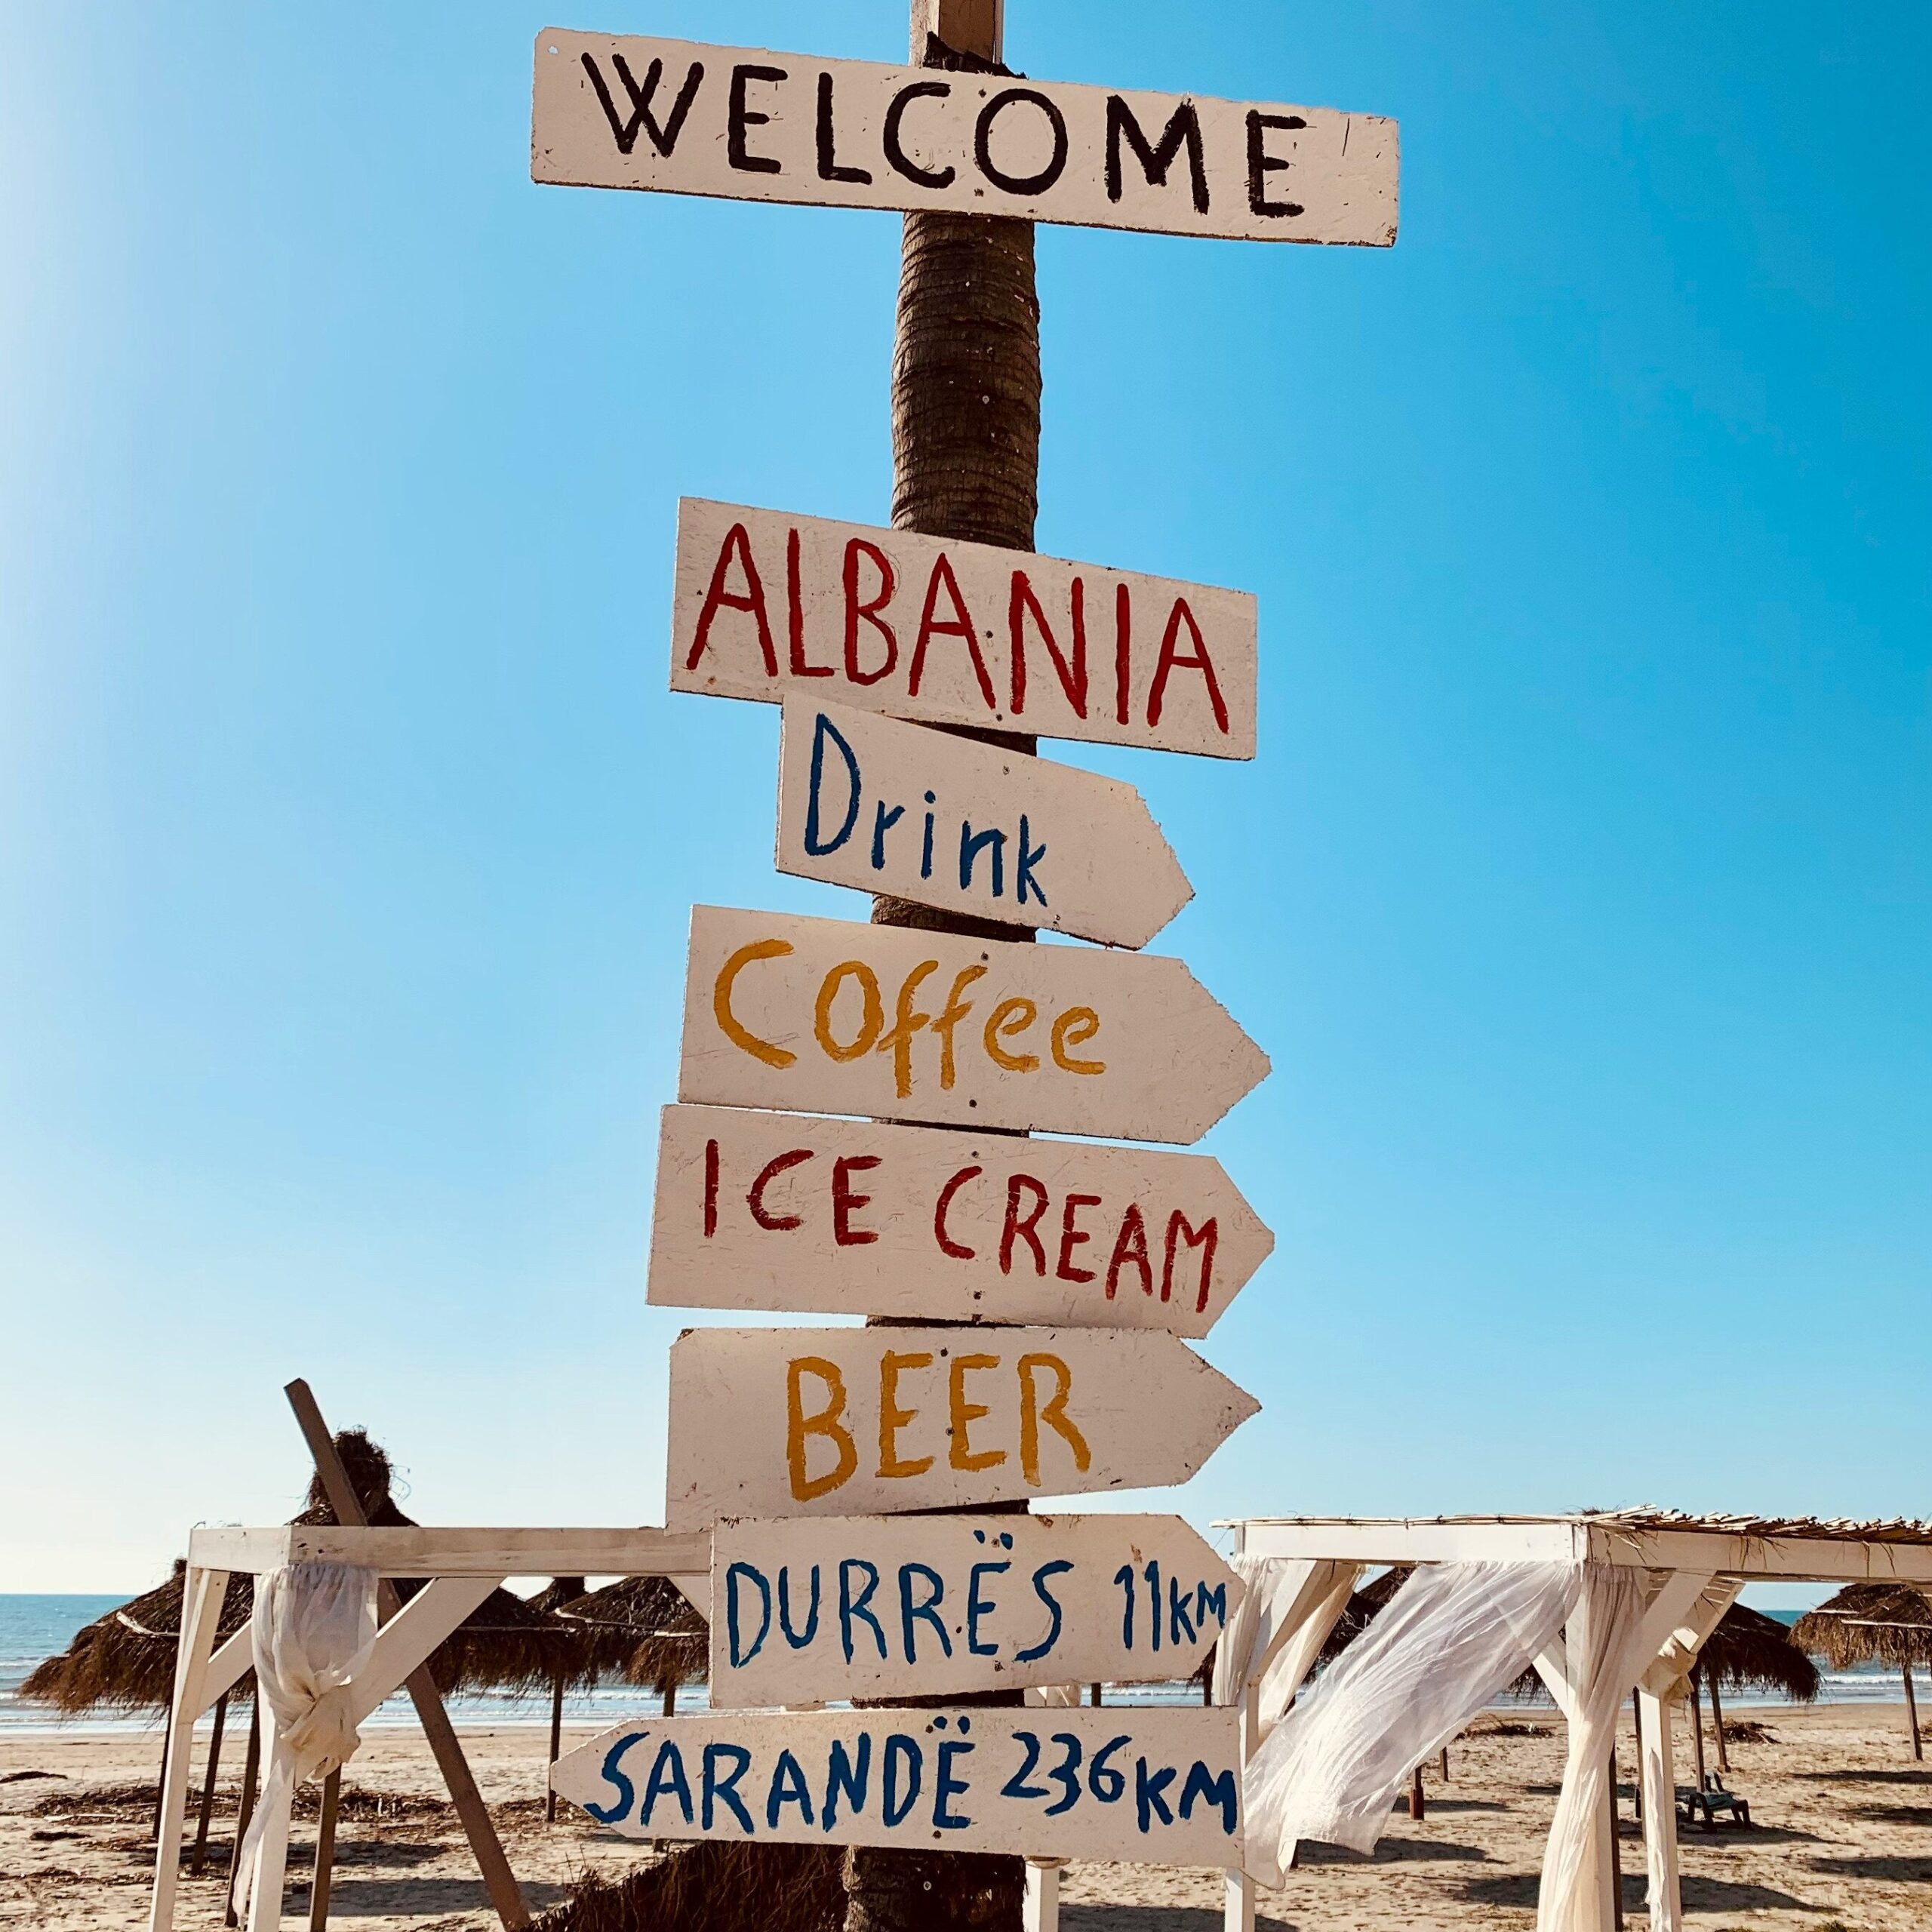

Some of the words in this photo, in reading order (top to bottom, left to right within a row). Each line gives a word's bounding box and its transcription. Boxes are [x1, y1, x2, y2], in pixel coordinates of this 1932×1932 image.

[580, 51, 1306, 218] WELCOME
[687, 522, 1229, 734] ALBANIA
[805, 712, 1048, 909] Drink
[705, 1140, 883, 1245] ICE
[935, 1168, 1218, 1311] CREAM
[787, 1350, 1091, 1501] BEER
[726, 1530, 1074, 1669] DURRËS
[584, 1716, 977, 1834] SARANDË
